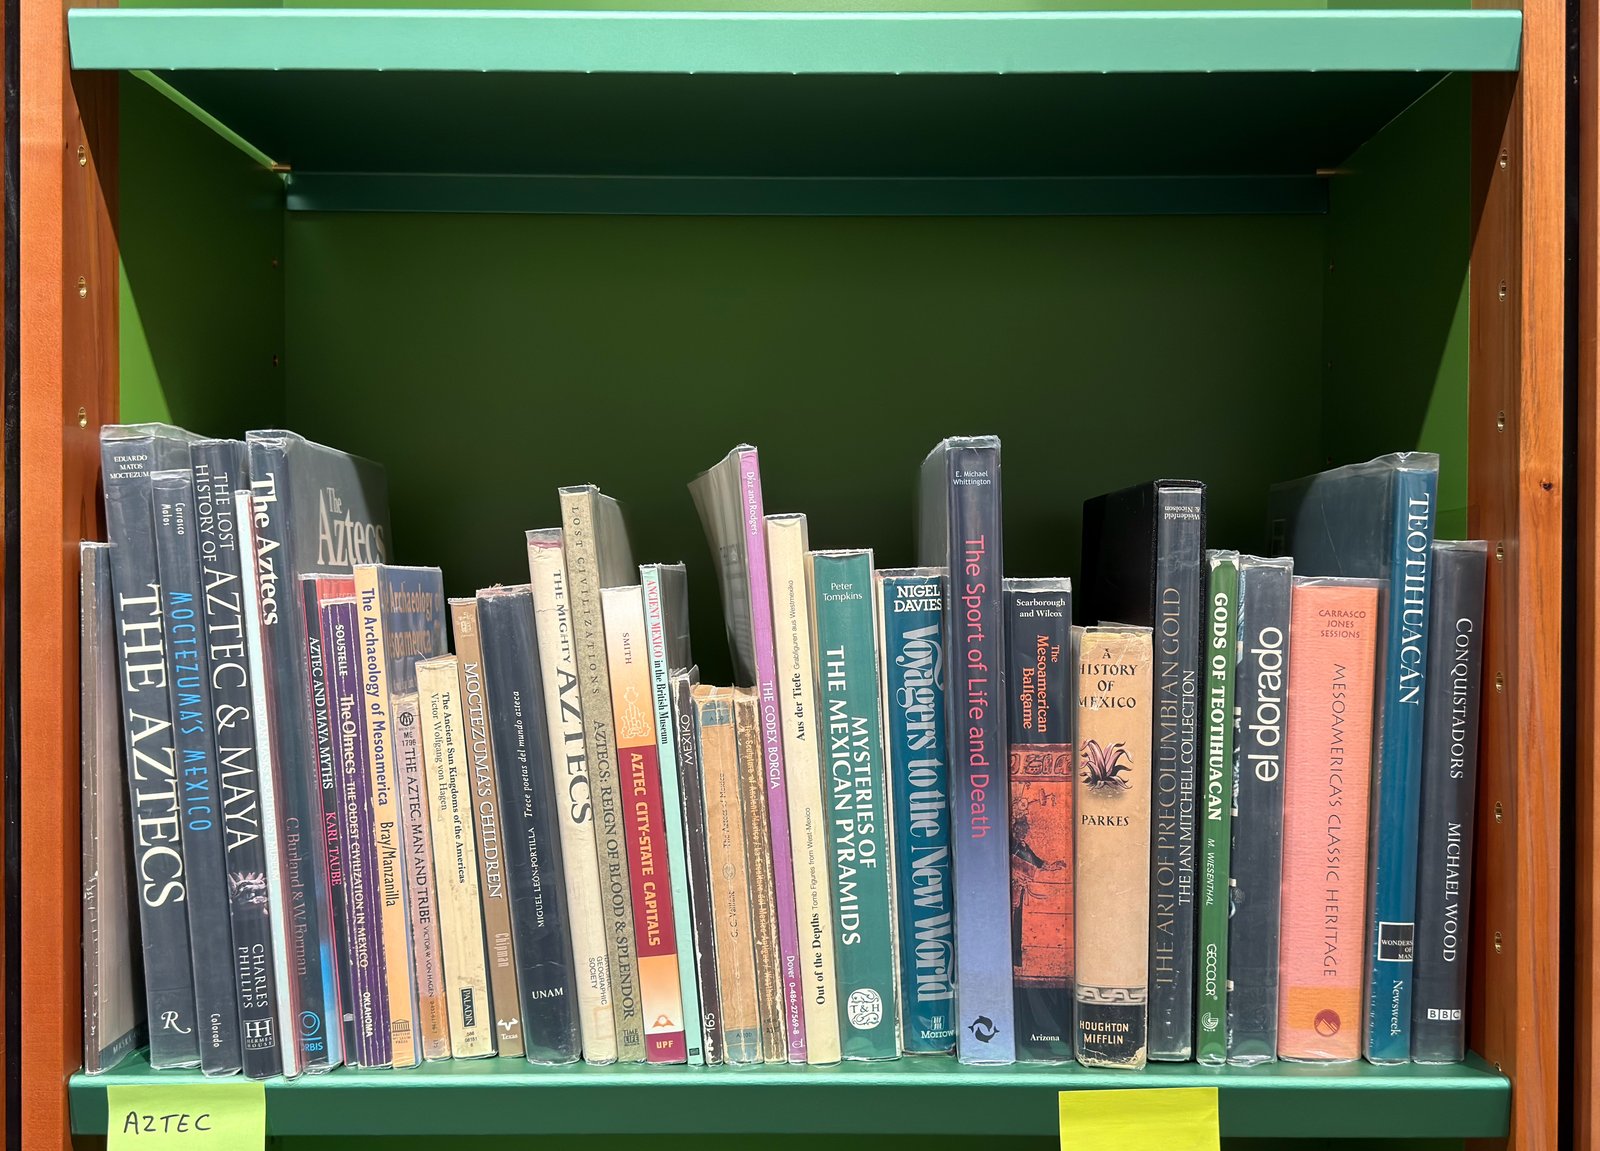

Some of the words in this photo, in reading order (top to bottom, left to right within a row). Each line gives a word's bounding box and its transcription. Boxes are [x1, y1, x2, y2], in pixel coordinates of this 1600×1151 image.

[113, 455, 147, 463] EDUARDO
[119, 463, 143, 471] MATOS
[963, 469, 989, 478] Michael
[196, 464, 215, 536] HISTORY
[214, 472, 229, 505] THE
[251, 473, 278, 528] The
[952, 478, 991, 487] Whittington
[161, 504, 173, 526] Matos
[175, 502, 185, 535] Carrasco
[218, 511, 235, 551] LOST
[317, 488, 386, 567] Aztecs
[571, 506, 583, 548] LOST
[749, 504, 758, 535] Rodgers
[965, 534, 985, 576] The
[257, 537, 281, 626] Aztecs
[361, 588, 376, 612] The
[647, 580, 660, 619] ANCIENT
[787, 579, 797, 619] Westmexiko
[823, 592, 863, 602] Tompkins
[831, 583, 854, 591] Peter
[896, 585, 941, 598] NIGEL
[1398, 492, 1430, 706] TEOTIHUACÁN
[962, 583, 986, 643] Sport
[1016, 598, 1066, 608] Scarborough
[1035, 608, 1063, 618] Wilcox
[1162, 587, 1181, 654] GOLD
[1212, 592, 1229, 649] GODS
[1318, 609, 1367, 619] CARRASCO
[120, 584, 167, 692] THE
[203, 566, 247, 690] AZTEC
[556, 603, 571, 664] MIGHTY
[577, 557, 600, 695] CIVILIZATIONS
[650, 621, 664, 658] MEXICO
[1320, 630, 1360, 639] SESSIONS
[1326, 620, 1354, 628] JONES
[308, 637, 323, 676] AZTEC
[335, 624, 348, 676] SOUSTELLE
[364, 617, 385, 697] Archaeology
[622, 632, 632, 664] SMITH
[790, 632, 801, 670] Grabfiguren
[967, 648, 988, 672] of
[1212, 654, 1226, 681] OF
[792, 673, 803, 699] Tiefe
[826, 645, 848, 692] THE
[895, 623, 945, 752] Voyagers
[1037, 634, 1049, 733] Mesoamerican
[1098, 680, 1115, 691] OF
[1249, 626, 1284, 747] dorado
[313, 680, 327, 707] AND
[430, 693, 440, 720] Victor
[512, 690, 521, 717] azteca
[656, 682, 668, 711] British
[762, 681, 775, 702] THE
[968, 679, 988, 720] Life
[1019, 667, 1035, 730] Ballgame
[1450, 618, 1473, 780] CONQUISTADORS
[216, 703, 250, 736] &
[316, 709, 330, 745] MAYA
[443, 712, 454, 747] Ancient
[514, 719, 524, 747] mundo
[659, 711, 669, 745] Museum
[764, 704, 778, 745] CODEX
[795, 721, 806, 741] Aus
[1180, 669, 1195, 764] COLLECTION
[343, 721, 359, 774] Olmecs
[402, 739, 417, 747] 1796
[433, 721, 444, 763] Wolfgang
[557, 667, 594, 824] AZTECS
[680, 715, 693, 766] MEXIKO
[745, 739, 756, 773] Sculpture
[829, 698, 852, 811] MEXICAN
[969, 726, 989, 766] and
[1157, 661, 1180, 849] PRECOLUMBIAN
[1207, 685, 1225, 820] TEOTIHUACAN
[320, 746, 334, 790] MYTHS
[372, 721, 391, 806] Mesoamerica
[520, 765, 531, 791] poetas
[630, 752, 647, 796] AZTEC
[768, 746, 781, 790] BORGIA
[852, 716, 875, 835] MYSTERIES
[1248, 754, 1279, 782] el
[130, 708, 185, 908] AZTECS
[184, 748, 212, 833] MEXICO
[220, 744, 259, 853] MAYA
[438, 782, 450, 812] Hagen
[447, 767, 460, 813] Kingdoms
[523, 795, 533, 818] Trece
[970, 774, 992, 839] Death
[1179, 767, 1194, 842] MITCHELL
[325, 812, 338, 845] KARL
[348, 803, 360, 839] OLDEST
[600, 786, 617, 837] REIGN
[803, 807, 813, 849] West-Mexico
[1081, 815, 1130, 827] PARKES
[412, 824, 425, 855] MAN
[635, 801, 654, 875] CITY-STATE
[858, 838, 878, 869] OF
[1325, 814, 1342, 881] CLASSIC
[288, 834, 305, 887] Burland
[329, 846, 342, 886] TAUBE
[350, 842, 364, 909] CIVILIZATION
[377, 821, 400, 907] Bray/Manzanilla
[455, 841, 467, 884] Americas
[808, 865, 818, 890] Figures
[911, 844, 949, 910] New
[1205, 852, 1215, 907] WIESENTHAL
[1444, 821, 1461, 901] MICHAEL
[478, 801, 502, 899] CHILDREN
[494, 931, 510, 968] Chipman
[608, 862, 625, 917] BLOOD
[810, 891, 820, 910] Tomb
[835, 819, 861, 946] PYRAMIDS
[1178, 875, 1192, 906] THE
[417, 888, 432, 925] TRIBE
[535, 894, 545, 928] MIGUEL
[643, 881, 661, 946] CAPITALS
[294, 924, 308, 975] Forman
[357, 927, 369, 968] MEXICO
[423, 927, 433, 952] VICTOR
[810, 912, 822, 949] Depths
[1323, 889, 1340, 977] HERITAGE
[1442, 903, 1458, 962] WOOD
[251, 943, 269, 1008] CHARLES
[588, 957, 598, 989] SOCIETY
[786, 956, 796, 980] Dover
[914, 911, 954, 1003] World
[239, 946, 253, 1009] PHILLIPS
[426, 974, 436, 998] HAGEN
[532, 987, 564, 999] UNAM
[596, 956, 607, 1005] GEOGRAPHIC
[616, 938, 635, 1021] SPLENDOR
[815, 985, 826, 1006] Out
[362, 992, 374, 1037] OKLAHOMA
[463, 989, 474, 1026] PALADIN
[704, 1012, 715, 1033] 165
[789, 982, 800, 1036] 0-486-27569-8
[1080, 1020, 1129, 1032] HOUGHTON
[1389, 980, 1404, 1036] Newsweek
[1428, 1009, 1461, 1020] BBC
[210, 1013, 222, 1047] Colorado
[624, 1035, 640, 1044] LIFE
[921, 1030, 955, 1039] Morrow
[1030, 1033, 1060, 1042] Arizona
[1083, 1033, 1124, 1045] MIFFLIN
[123, 1110, 211, 1135] AZTEC
